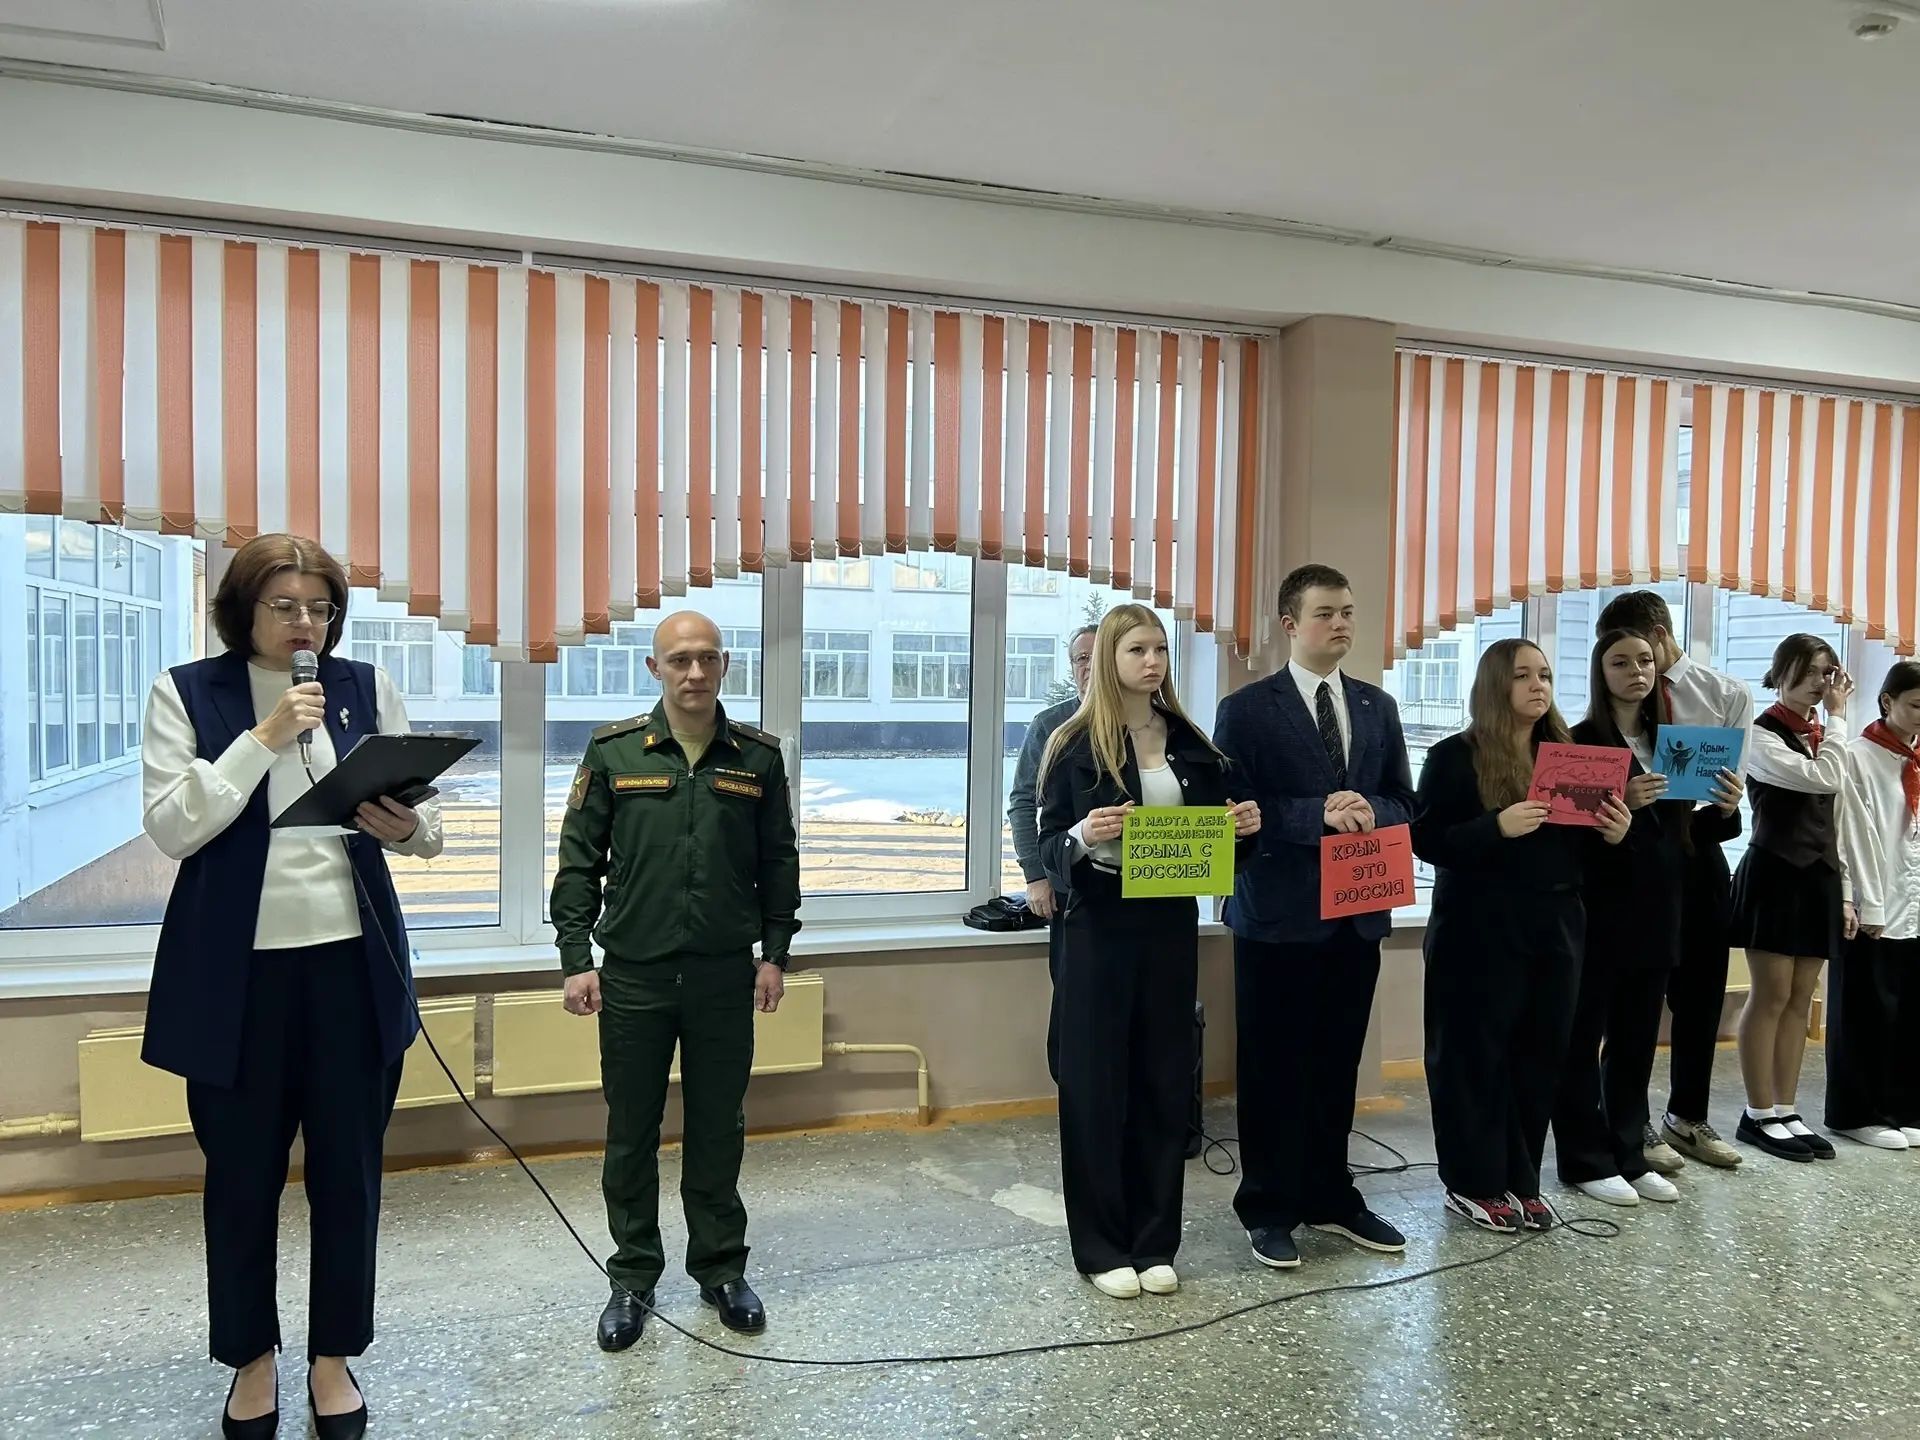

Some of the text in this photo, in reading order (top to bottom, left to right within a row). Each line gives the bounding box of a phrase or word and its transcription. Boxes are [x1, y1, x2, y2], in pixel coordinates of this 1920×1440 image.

[1699, 741, 1730, 755] Крым-
[1129, 816, 1227, 827] 18 МАРТА ДЕНЬ
[1129, 829, 1223, 840] ВОССОЕДИНЕНИЯ
[1129, 843, 1212, 859] КРЫМА С
[1332, 839, 1380, 861] КРЫМ
[1129, 860, 1210, 880] РОССИЕЙ
[1352, 861, 1387, 880] ЭТО
[1334, 879, 1404, 906] РОССИЯ
